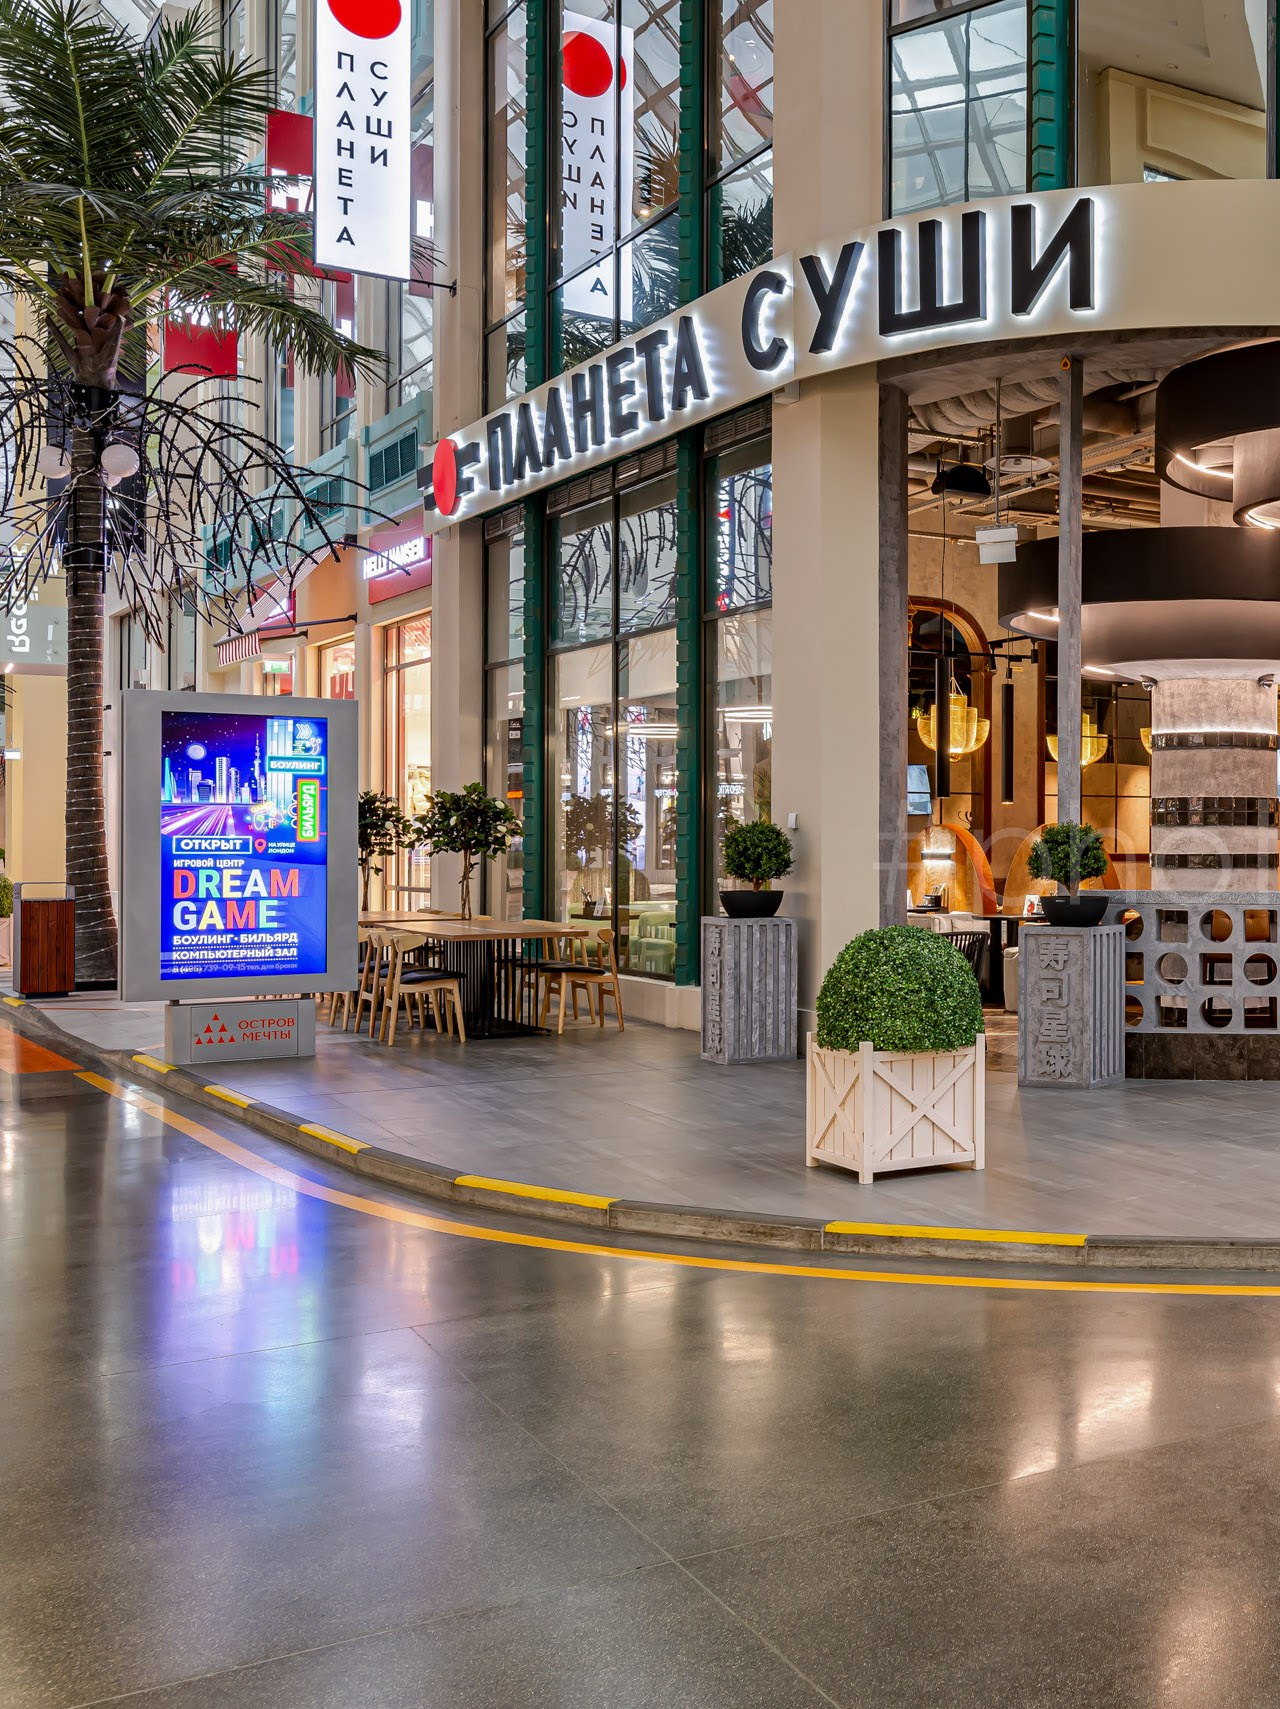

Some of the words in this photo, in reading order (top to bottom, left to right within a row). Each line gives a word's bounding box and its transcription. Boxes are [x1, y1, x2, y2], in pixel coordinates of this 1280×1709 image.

[365, 61, 393, 168] СУШИ
[335, 50, 356, 246] ПЛАНЕТА
[486, 316, 710, 491] ПЛАНЕТА
[741, 197, 1096, 373] СУШИ
[270, 760, 320, 770] БОУЛИНГ
[302, 785, 315, 837] БИЛЬЯРД
[180, 839, 243, 850] ОТКРЫТ
[173, 858, 214, 868] ИГРОВОЙ
[216, 859, 245, 868] ЦЕНТР
[173, 868, 299, 899] DREAM
[173, 899, 279, 931] GAME
[173, 934, 234, 946] БОУЛИНГ
[240, 932, 298, 944] БИЛЬЯРД
[173, 947, 274, 960] КОМПЬЮТЕРНЫЙ
[275, 948, 298, 957] ЗАЛ
[1038, 937, 1073, 1079] 寿司星球
[238, 1017, 295, 1030] ОСТРОВ
[242, 1030, 291, 1042] МЕЧТЫ
